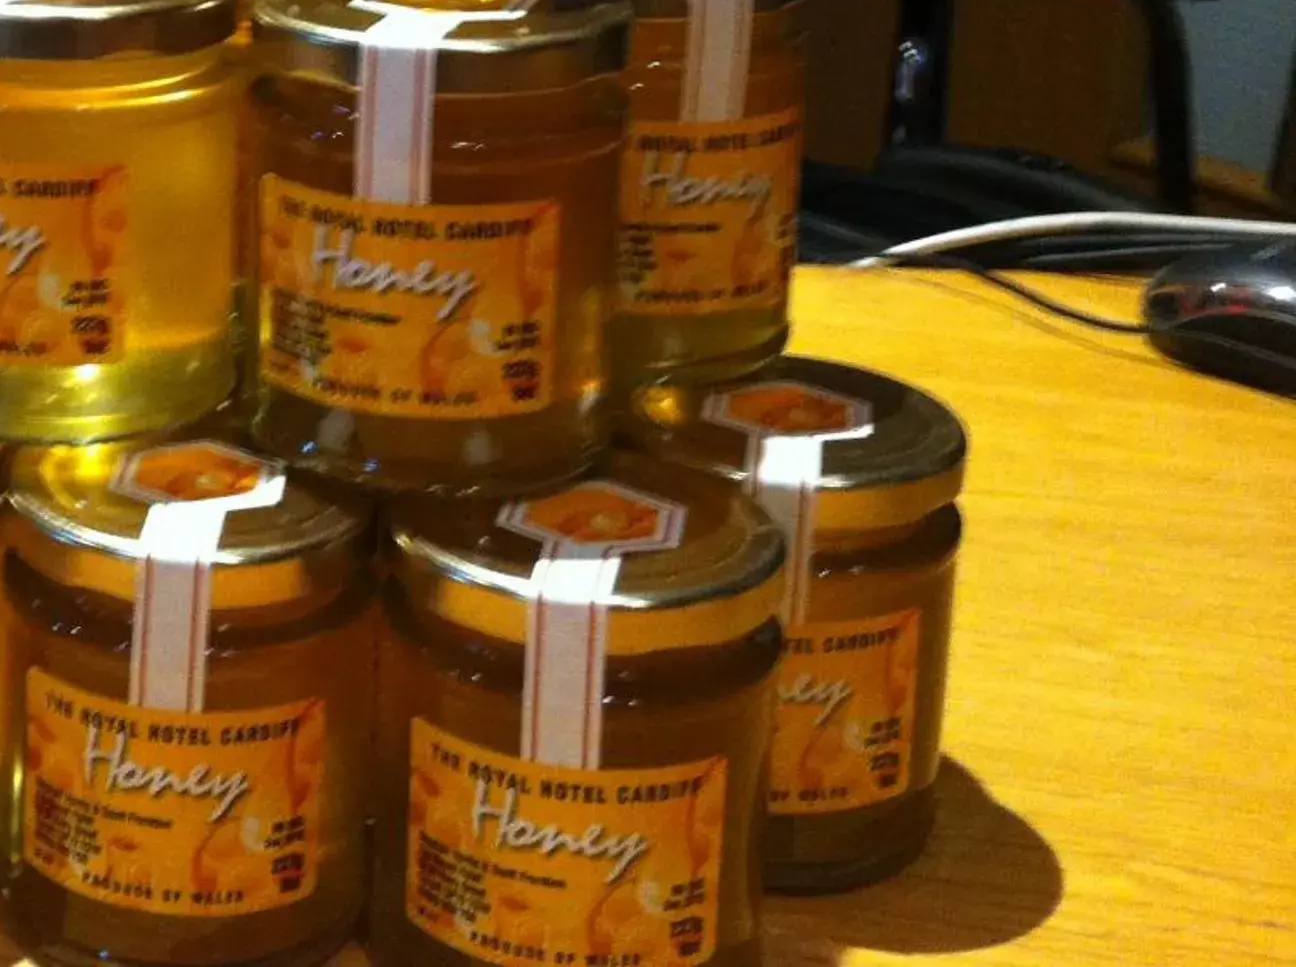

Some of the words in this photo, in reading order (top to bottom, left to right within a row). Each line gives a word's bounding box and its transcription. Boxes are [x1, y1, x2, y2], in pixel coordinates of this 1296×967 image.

[639, 149, 773, 226] Honey
[312, 221, 481, 323] Honey
[43, 691, 74, 720] THE
[147, 723, 211, 747] HOTEL
[219, 716, 302, 746] CARDIFF
[82, 724, 252, 823] Honey
[430, 742, 461, 772] THE
[467, 760, 530, 795] ROYAL
[539, 779, 608, 805] HOTEL
[615, 775, 704, 806] CARDIFF
[471, 777, 650, 884] Honey
